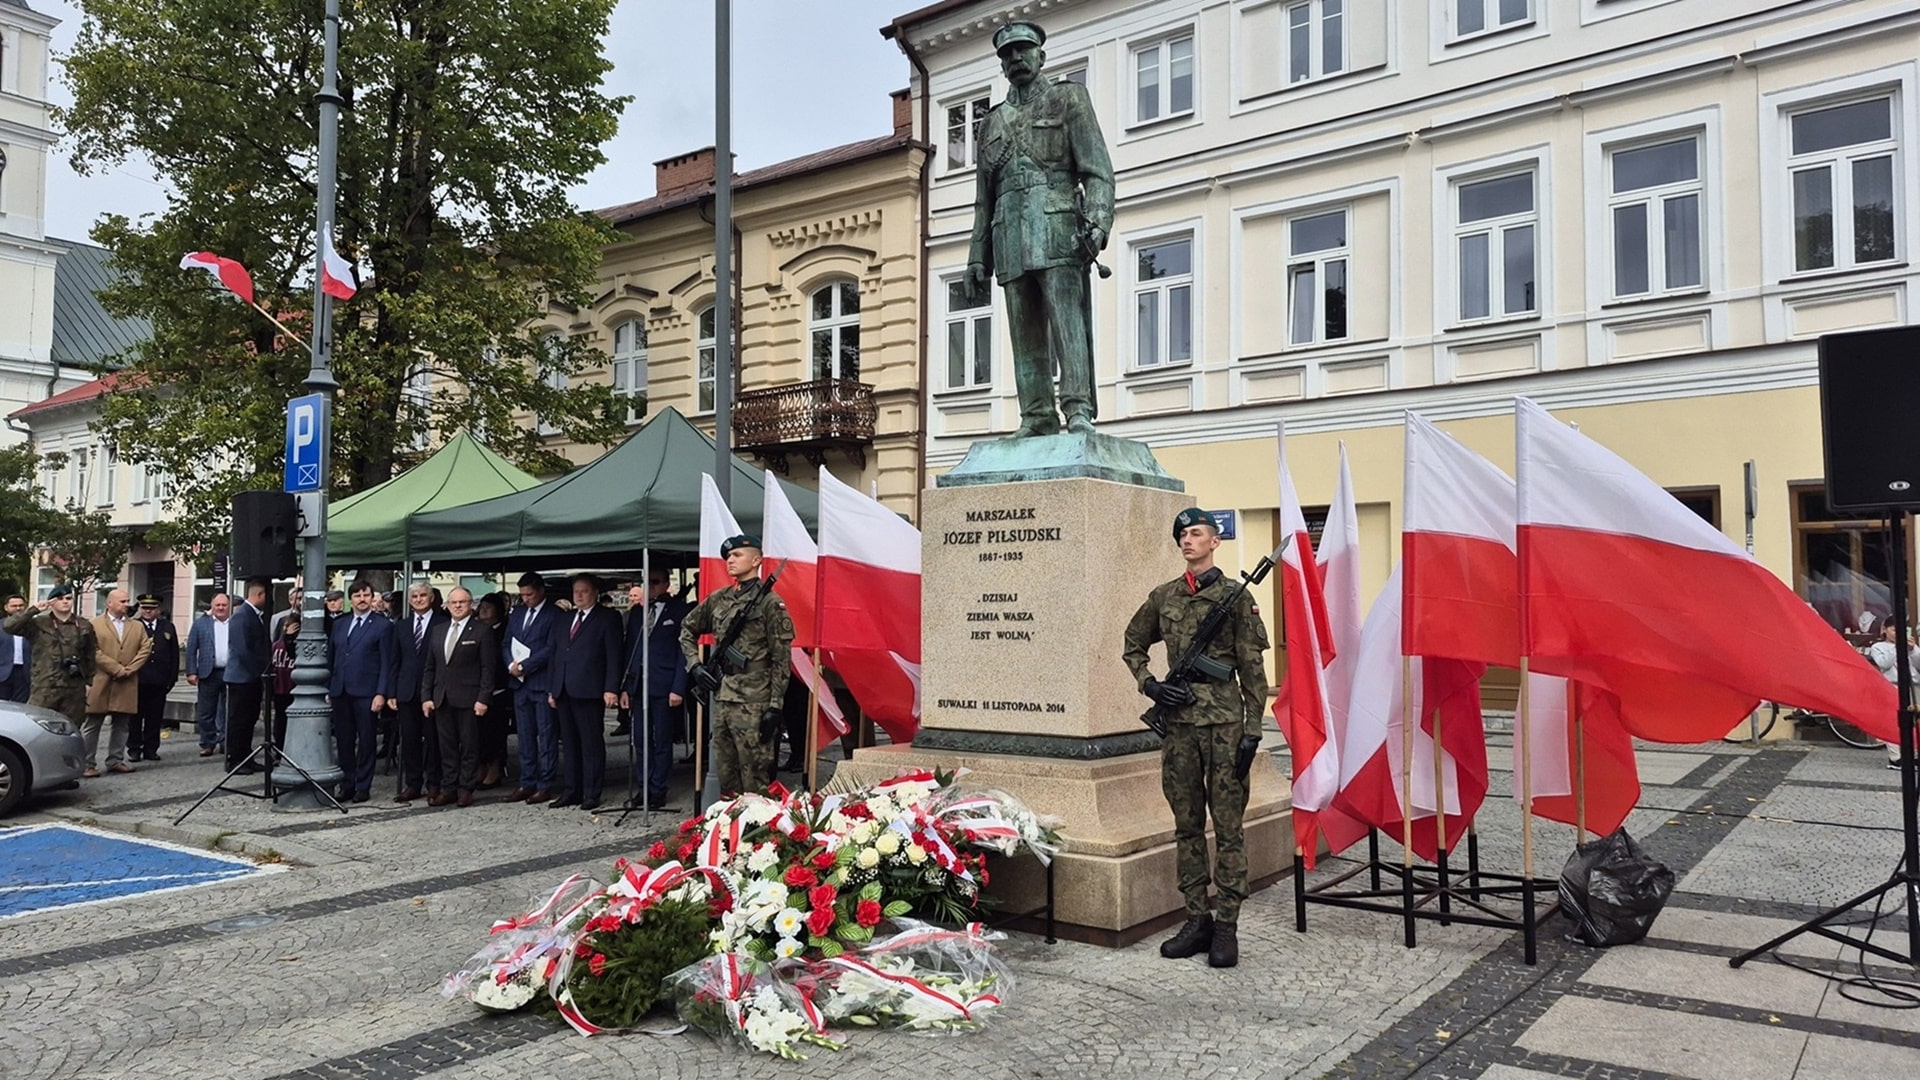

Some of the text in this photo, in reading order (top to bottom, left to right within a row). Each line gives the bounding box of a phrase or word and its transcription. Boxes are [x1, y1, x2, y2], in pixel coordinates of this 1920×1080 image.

[293, 404, 314, 464] P
[966, 508, 1036, 522] MARSZAŁEK
[943, 528, 1062, 545] JÓZEF PIŁSUDSKI
[978, 552, 1023, 562] 1867-1935
[966, 612, 1034, 621] ZIEMIA WASZA
[970, 631, 991, 640] JEST
[937, 699, 977, 709] SUWAŁKI
[992, 701, 1043, 712] LISTOPADA
[1046, 703, 1065, 713] 2014
